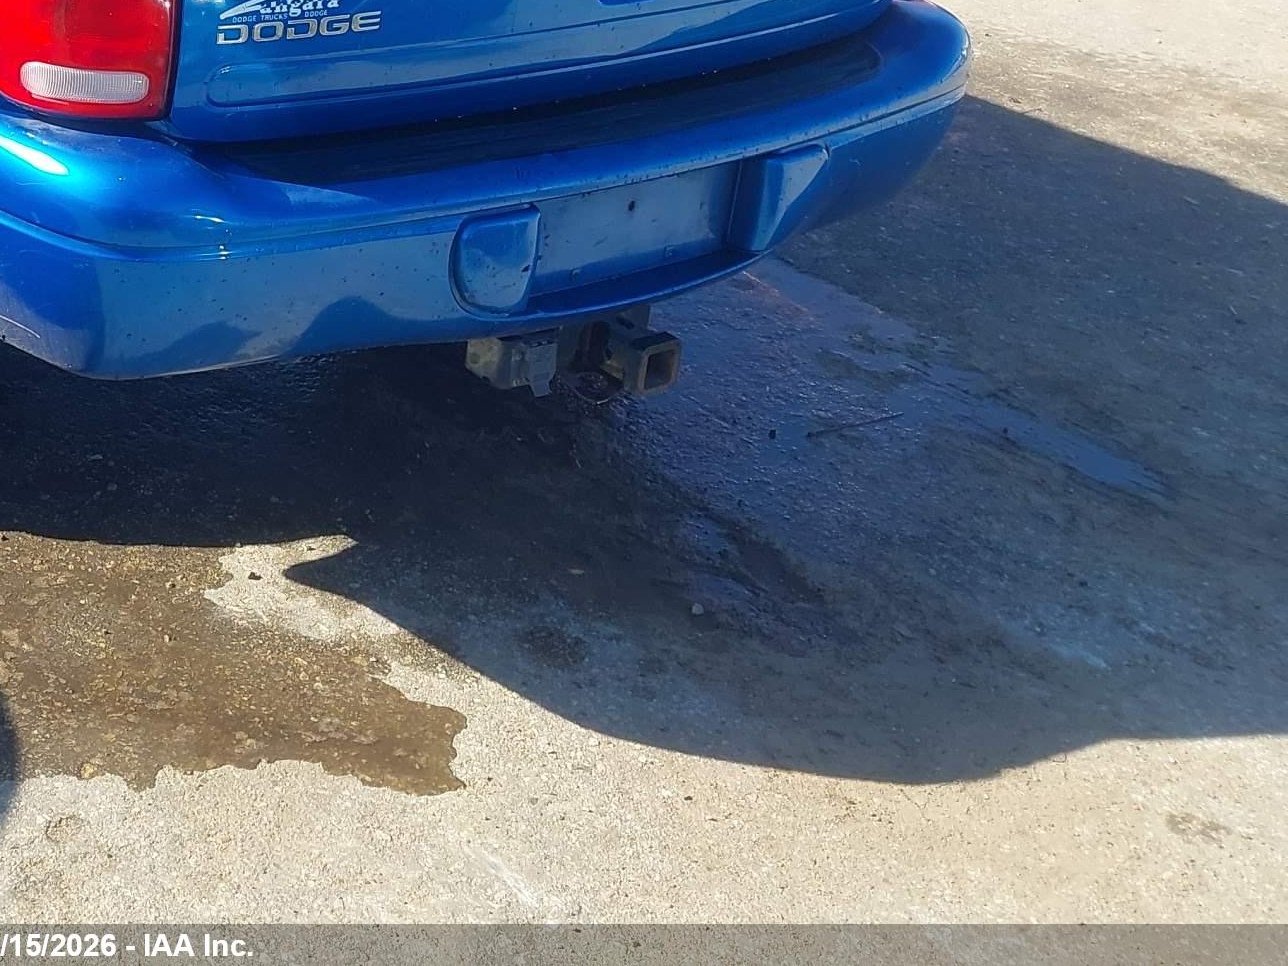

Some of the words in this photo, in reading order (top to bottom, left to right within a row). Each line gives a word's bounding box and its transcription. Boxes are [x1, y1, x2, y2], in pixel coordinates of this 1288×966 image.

[216, 10, 381, 45] DODGE
[232, 14, 257, 23] DODGE
[261, 13, 288, 21] TRUCKS
[304, 9, 328, 18] DODGE
